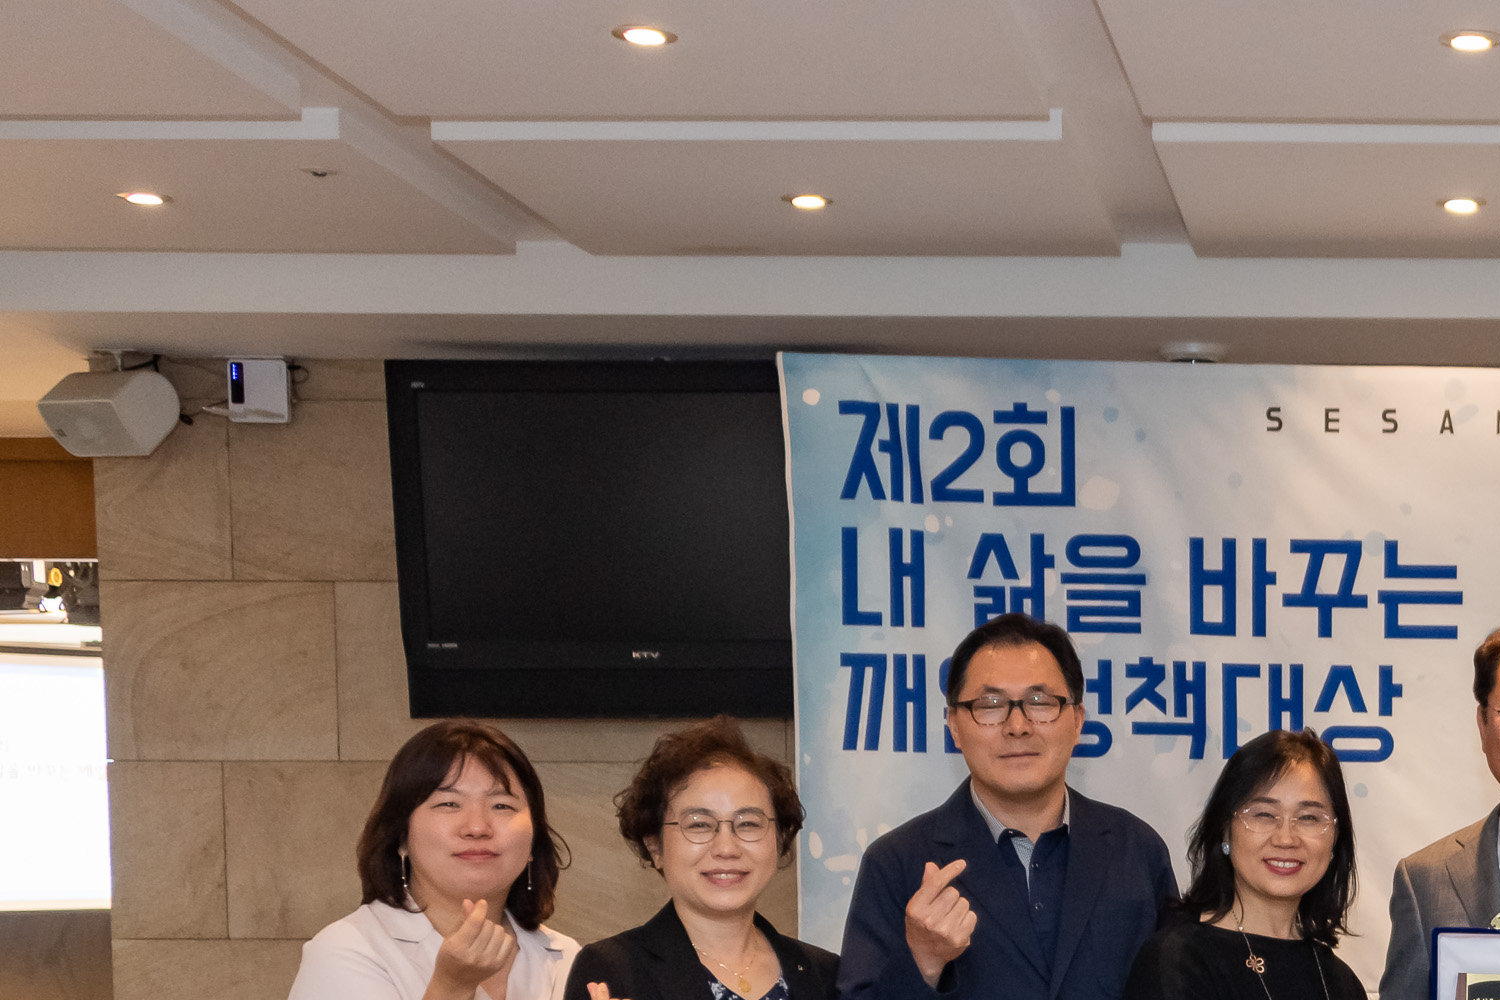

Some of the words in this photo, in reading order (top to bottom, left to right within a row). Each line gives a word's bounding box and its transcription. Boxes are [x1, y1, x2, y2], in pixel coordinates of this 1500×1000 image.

[838, 400, 1076, 507] 제2회
[840, 526, 926, 629] 내
[967, 532, 1147, 634] 삶을
[1188, 536, 1464, 640] 바꾸는
[839, 652, 1403, 763] 깨책대상
